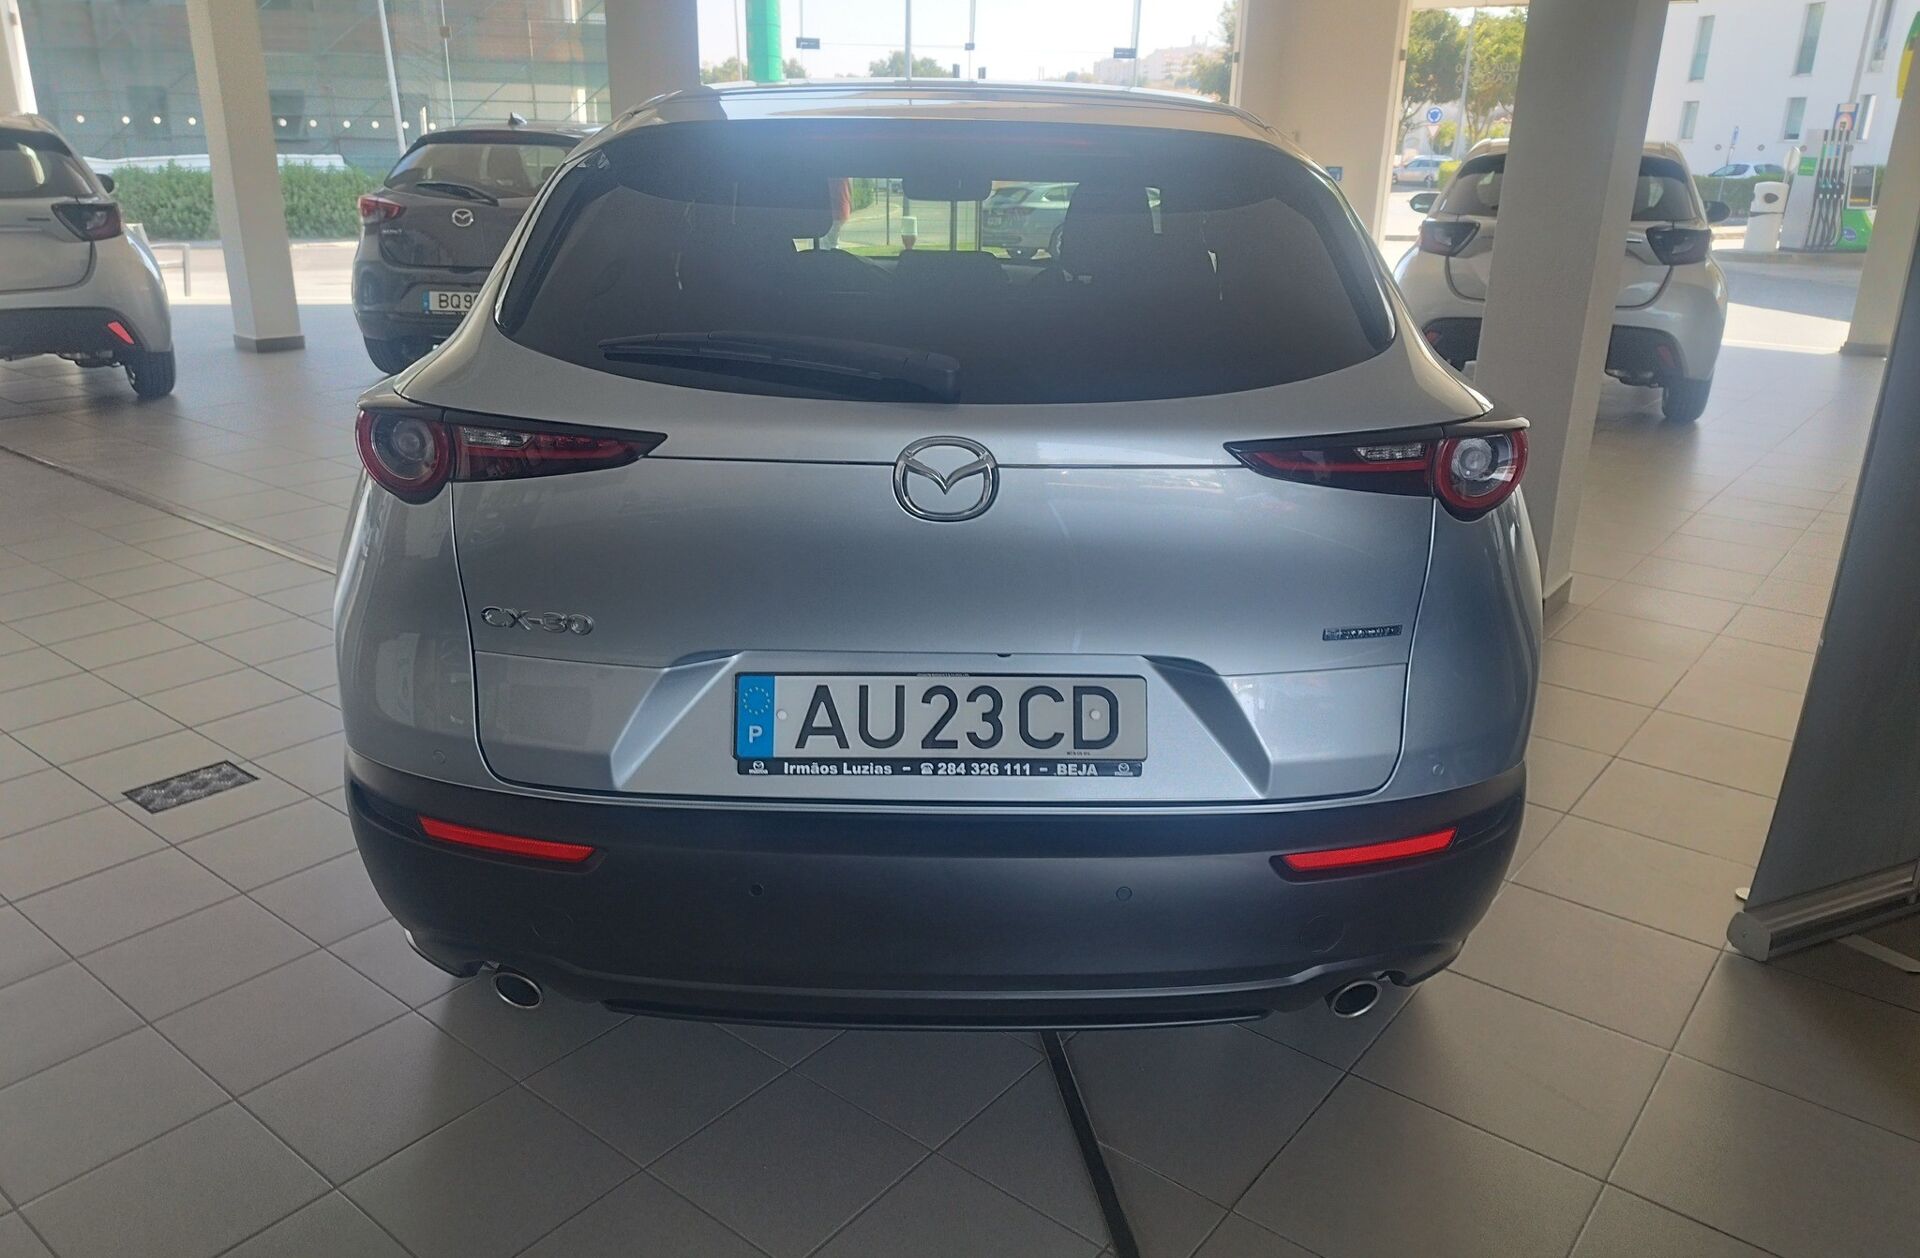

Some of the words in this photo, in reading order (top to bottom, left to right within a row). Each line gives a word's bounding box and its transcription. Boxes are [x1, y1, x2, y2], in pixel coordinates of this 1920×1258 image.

[438, 293, 480, 310] BQ9
[480, 605, 594, 636] CX-30
[748, 725, 763, 744] P
[783, 761, 839, 775] Irmãos
[842, 762, 893, 775] Luzias
[937, 762, 967, 776] 284
[970, 762, 999, 776] 326
[1003, 763, 1031, 776] 111
[1056, 763, 1099, 776] BEJA
